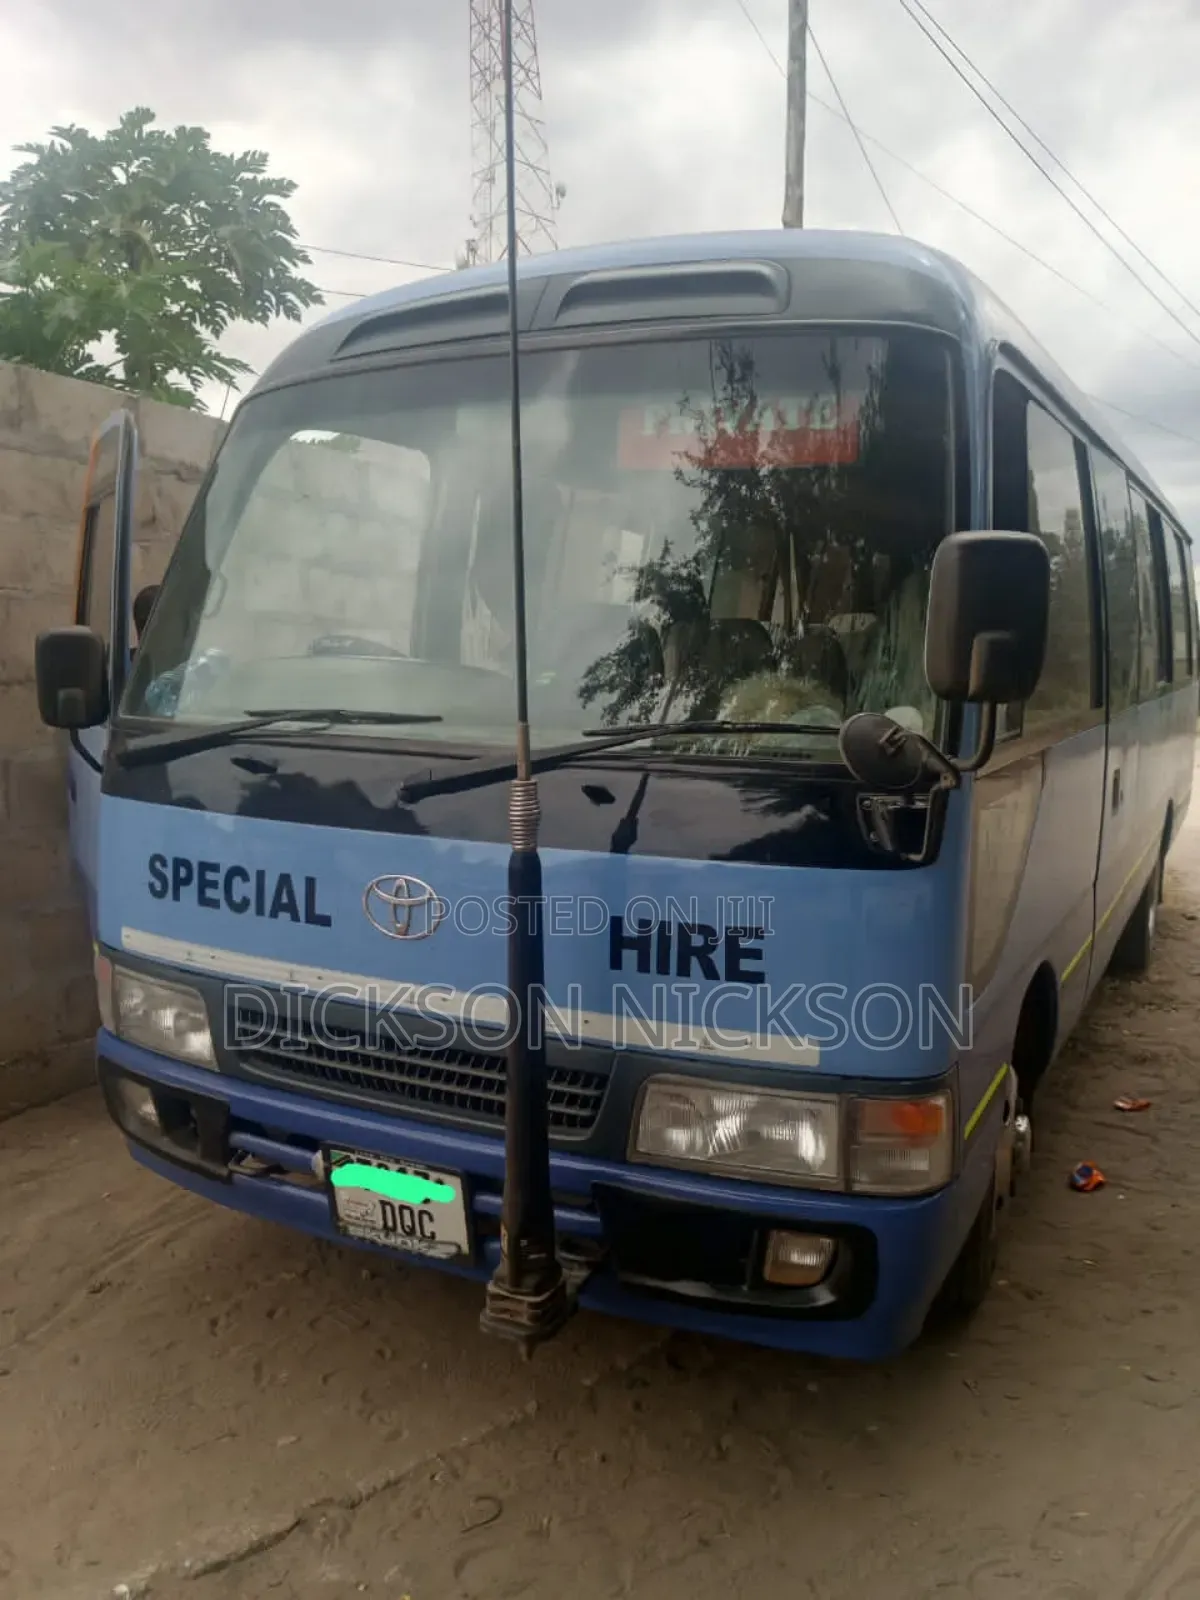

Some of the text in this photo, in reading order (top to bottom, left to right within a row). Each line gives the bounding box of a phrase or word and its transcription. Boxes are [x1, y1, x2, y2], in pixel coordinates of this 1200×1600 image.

[148, 853, 765, 983] SPECIAL HIRE
[379, 1200, 436, 1240] DQC
